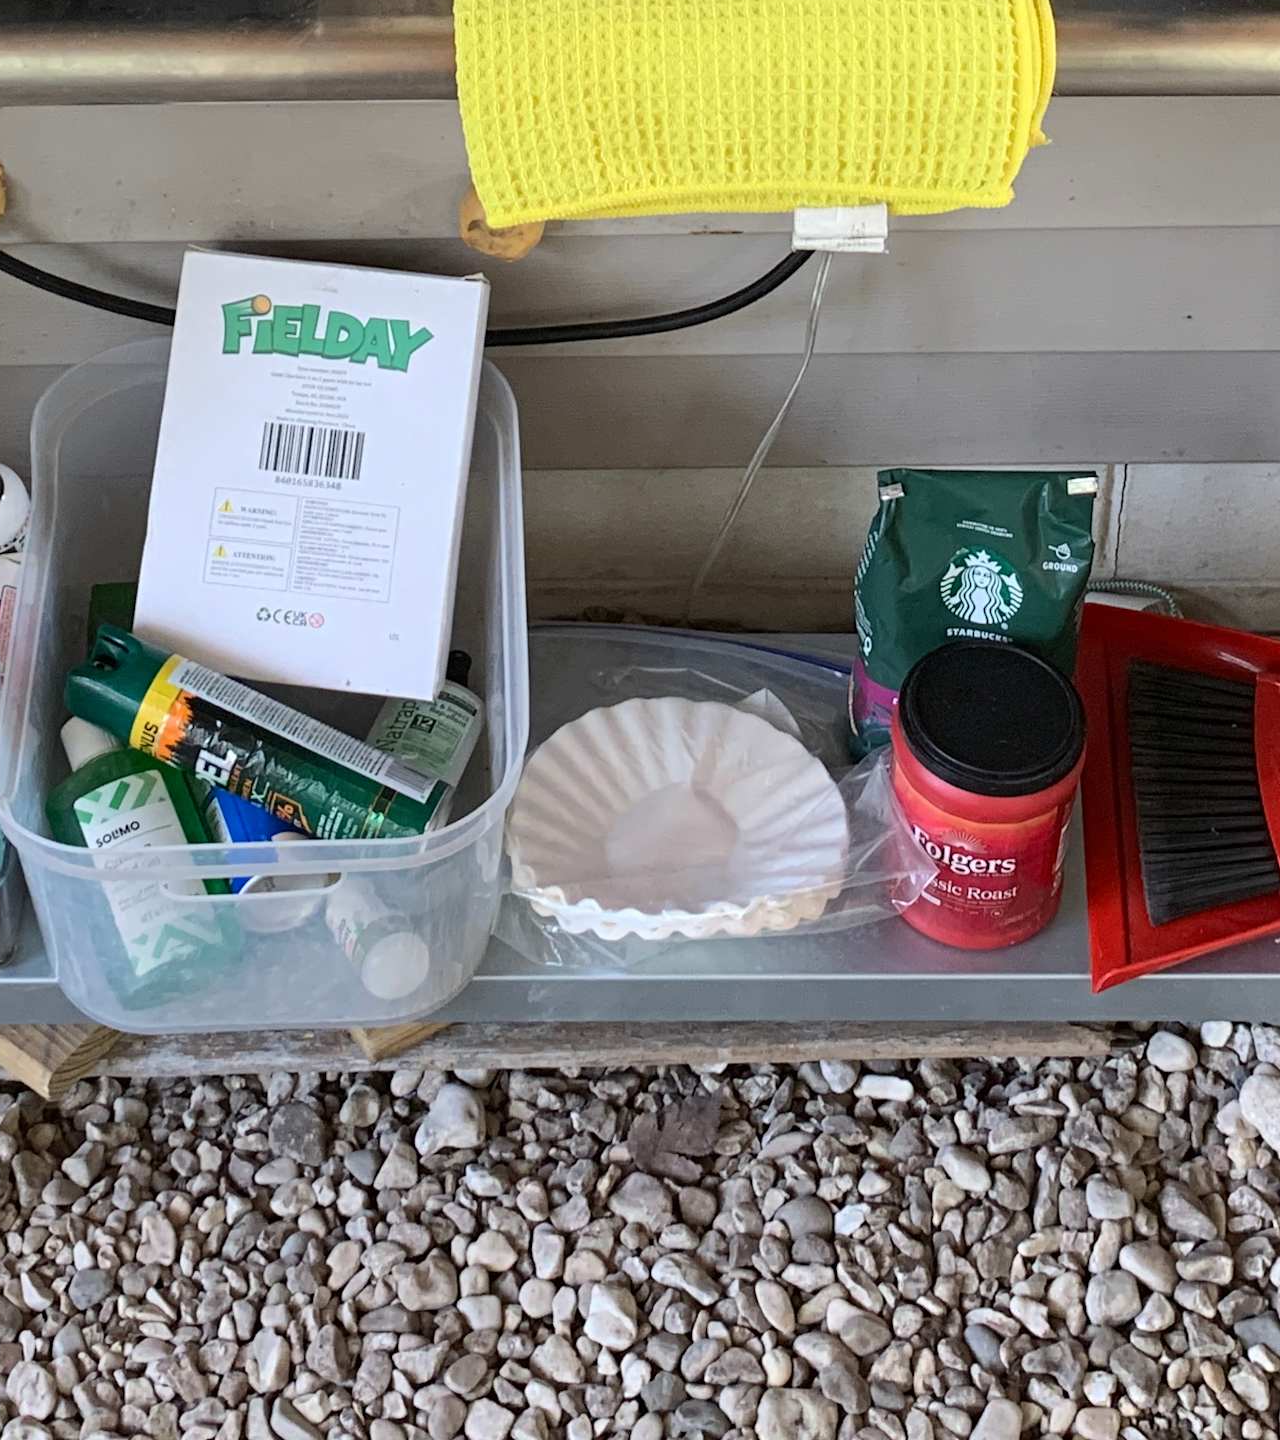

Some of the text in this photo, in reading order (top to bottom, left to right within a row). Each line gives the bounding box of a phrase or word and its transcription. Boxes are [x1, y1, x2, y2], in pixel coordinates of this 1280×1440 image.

[1042, 561, 1078, 573] GROUND
[375, 700, 417, 752] Natrap
[912, 824, 1016, 875] Folgers
[931, 877, 962, 897] ssic
[967, 885, 1017, 901] Roast
